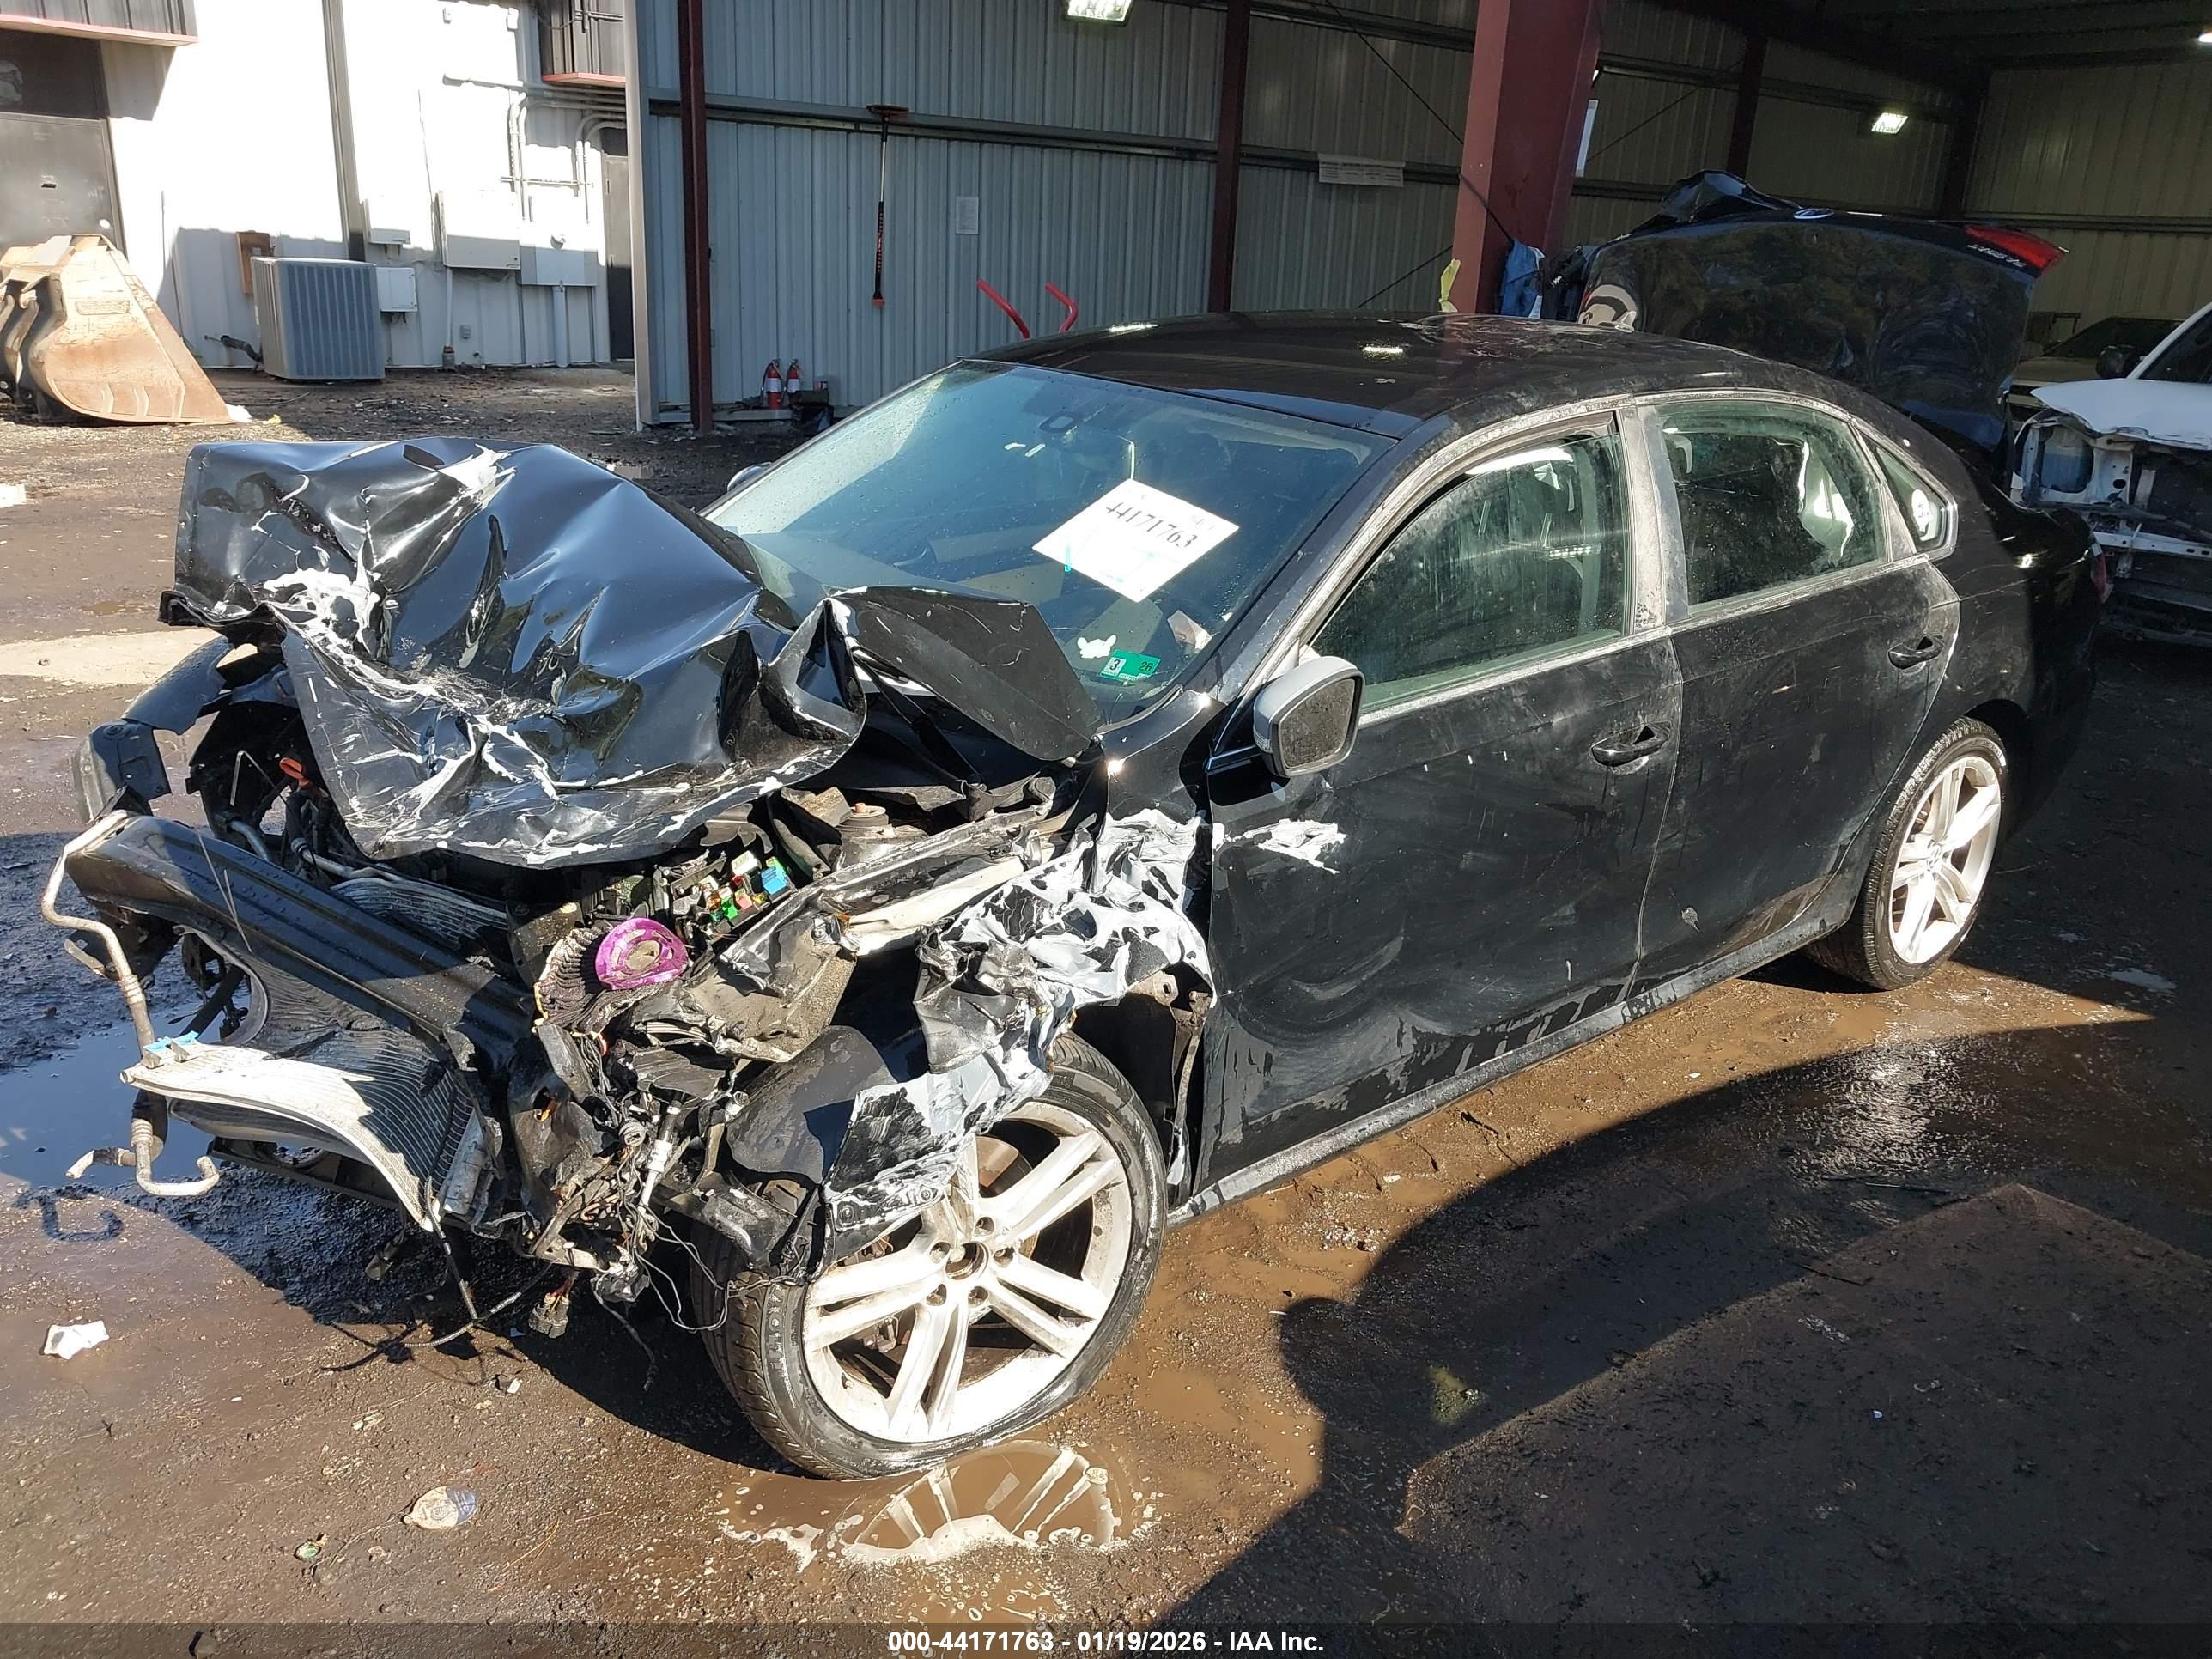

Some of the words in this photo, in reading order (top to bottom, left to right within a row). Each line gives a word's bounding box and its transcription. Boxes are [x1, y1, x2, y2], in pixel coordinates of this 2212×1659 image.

[1106, 501, 1198, 549] 44171763
[1109, 659, 1121, 671] 3
[1139, 661, 1154, 672] 26
